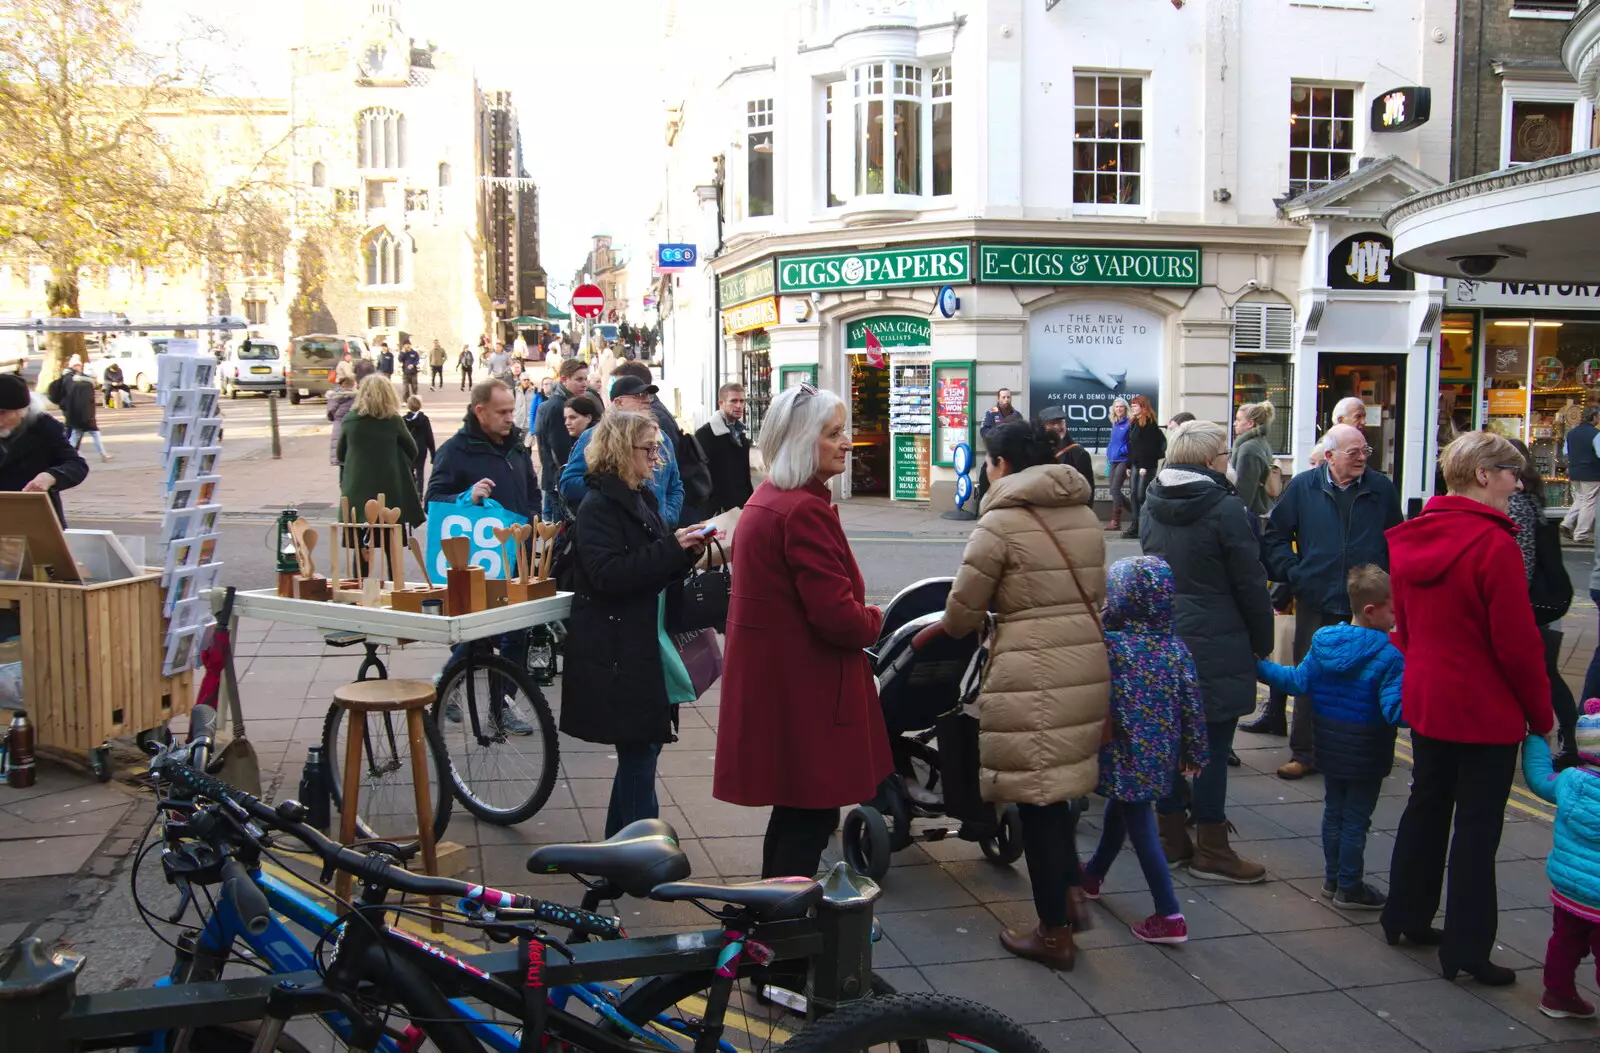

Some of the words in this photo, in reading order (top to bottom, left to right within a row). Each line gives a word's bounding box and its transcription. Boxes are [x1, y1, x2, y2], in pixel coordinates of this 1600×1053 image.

[782, 260, 840, 286] CIGS
[864, 251, 964, 281] PAPERS
[985, 252, 1064, 276] E-CIGS
[1070, 254, 1089, 276] &
[1093, 255, 1193, 278] VAPOURS
[1345, 241, 1391, 282] JIVE
[1069, 314, 1091, 323] THE
[1098, 314, 1123, 324] NEW
[1044, 324, 1125, 334] ALTERNATIVE
[1132, 325, 1147, 335] TO
[1068, 335, 1123, 345] SMOKING
